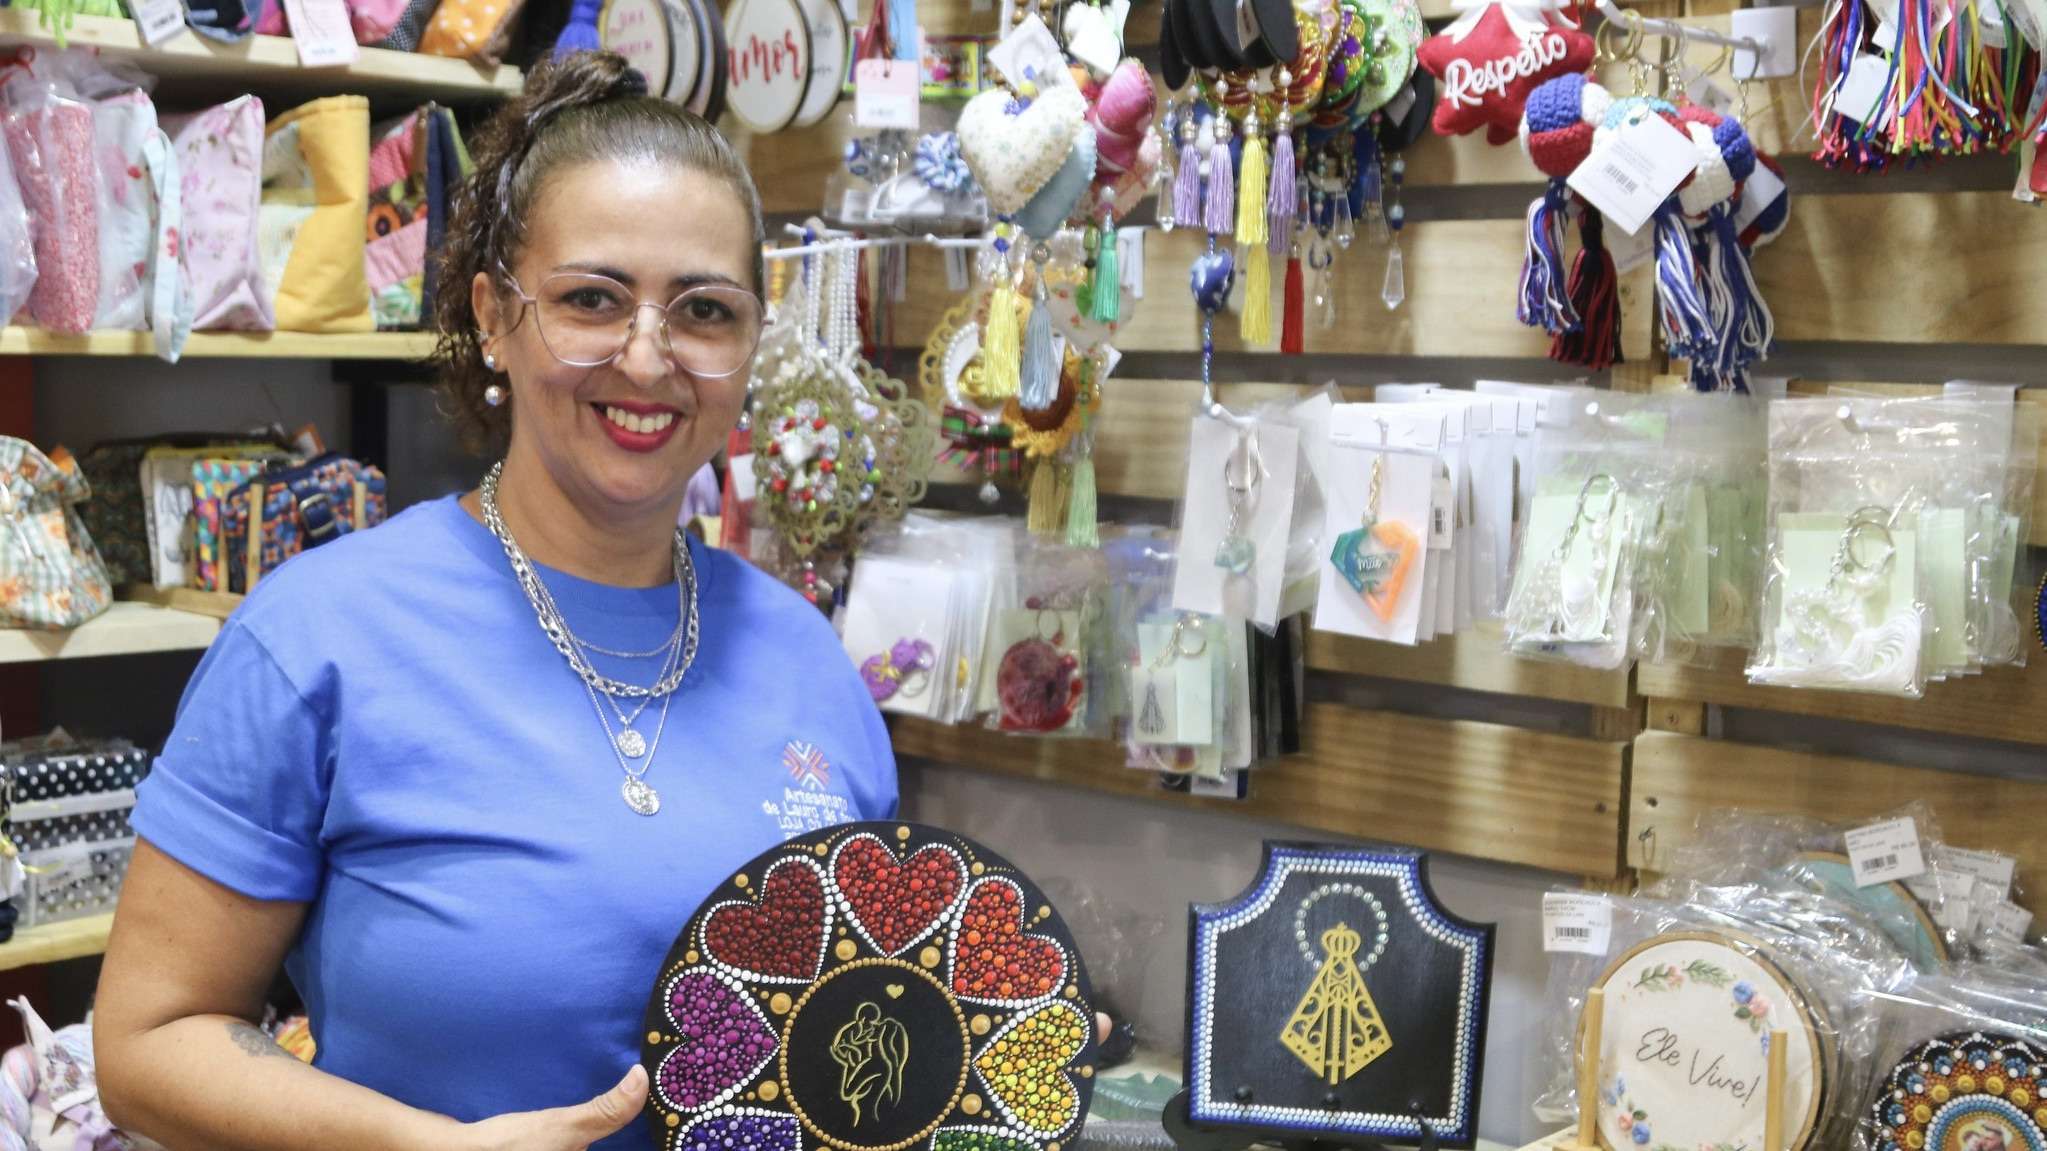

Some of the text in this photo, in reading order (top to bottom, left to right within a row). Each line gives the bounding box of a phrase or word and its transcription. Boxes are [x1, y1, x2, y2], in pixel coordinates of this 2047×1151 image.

[1445, 32, 1567, 110] Respeito
[784, 787, 848, 812] Artesanato
[1636, 1027, 1762, 1109] Ele Vive!
